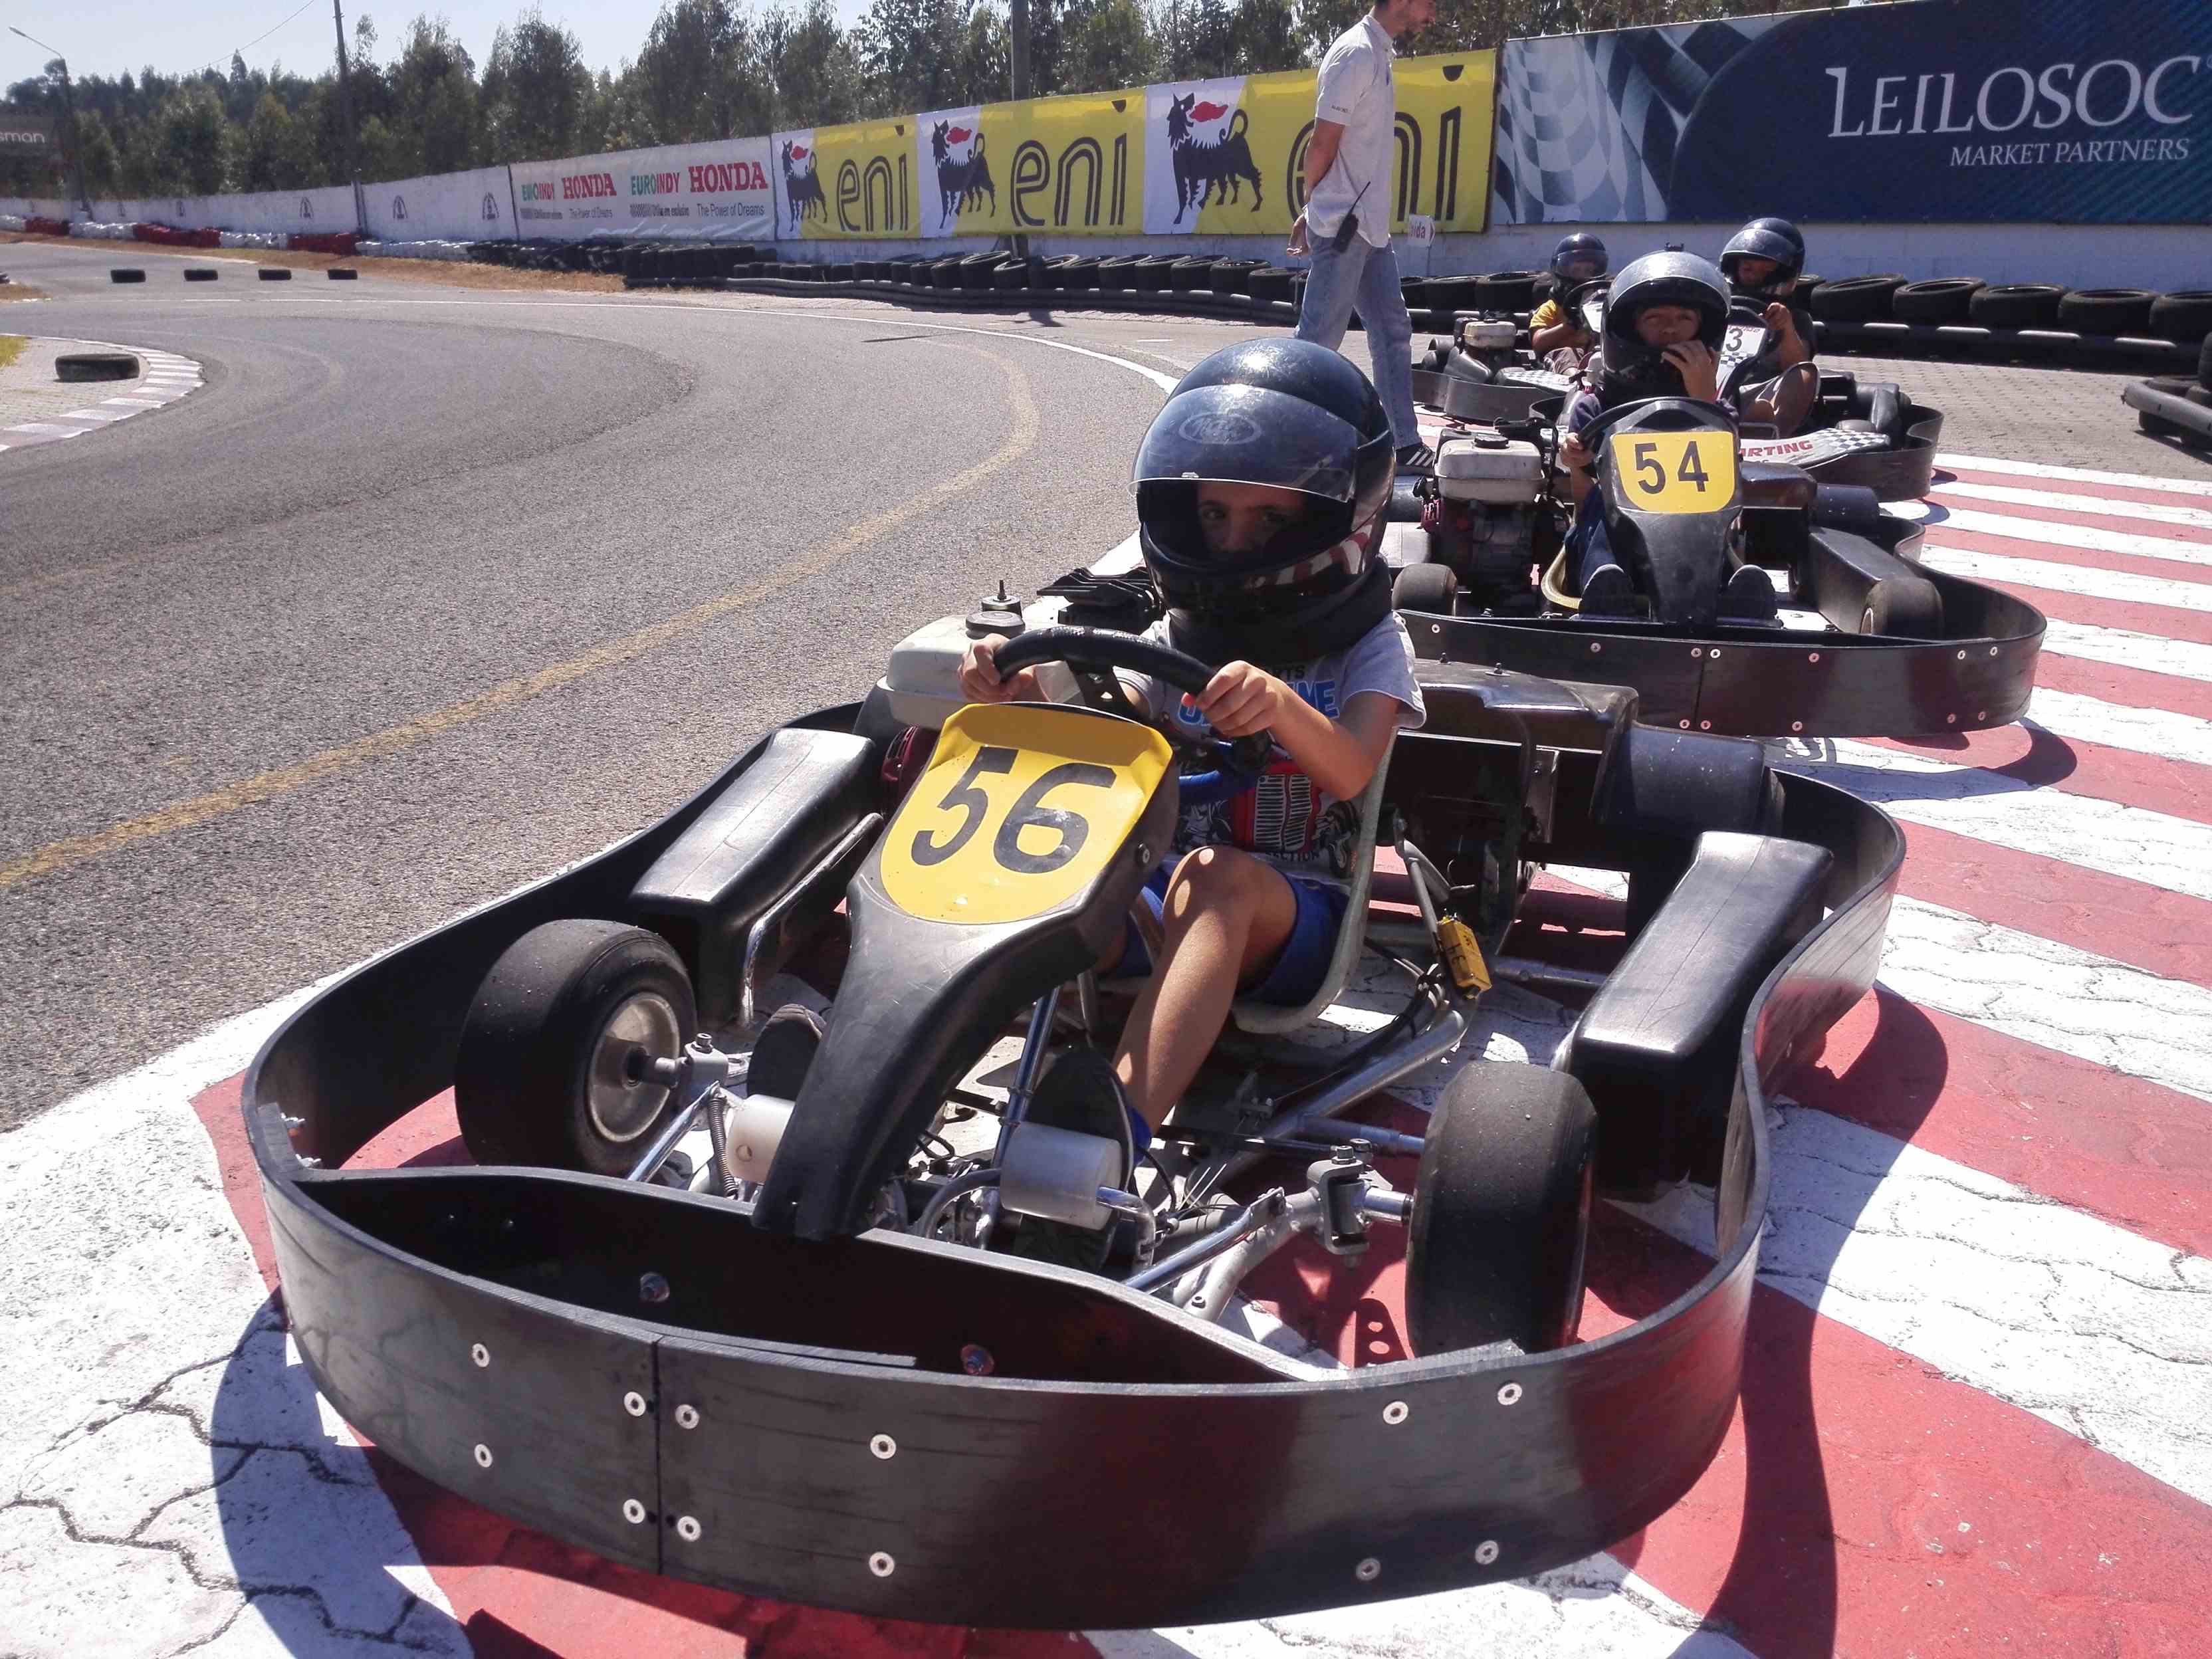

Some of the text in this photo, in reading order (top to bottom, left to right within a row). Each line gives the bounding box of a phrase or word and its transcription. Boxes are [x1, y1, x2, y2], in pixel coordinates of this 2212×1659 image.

[1825, 56, 2201, 138] LEILOSOC
[631, 162, 768, 195] EUROINDY HONDA
[837, 124, 909, 232] eni
[1010, 99, 1127, 227] eni
[1949, 138, 2190, 167] MARKET PARTNERS
[562, 173, 617, 199] HONDA
[697, 203, 709, 217] The
[738, 202, 765, 217] Dreams
[1634, 441, 1709, 495] 54
[911, 746, 1117, 874] 56
